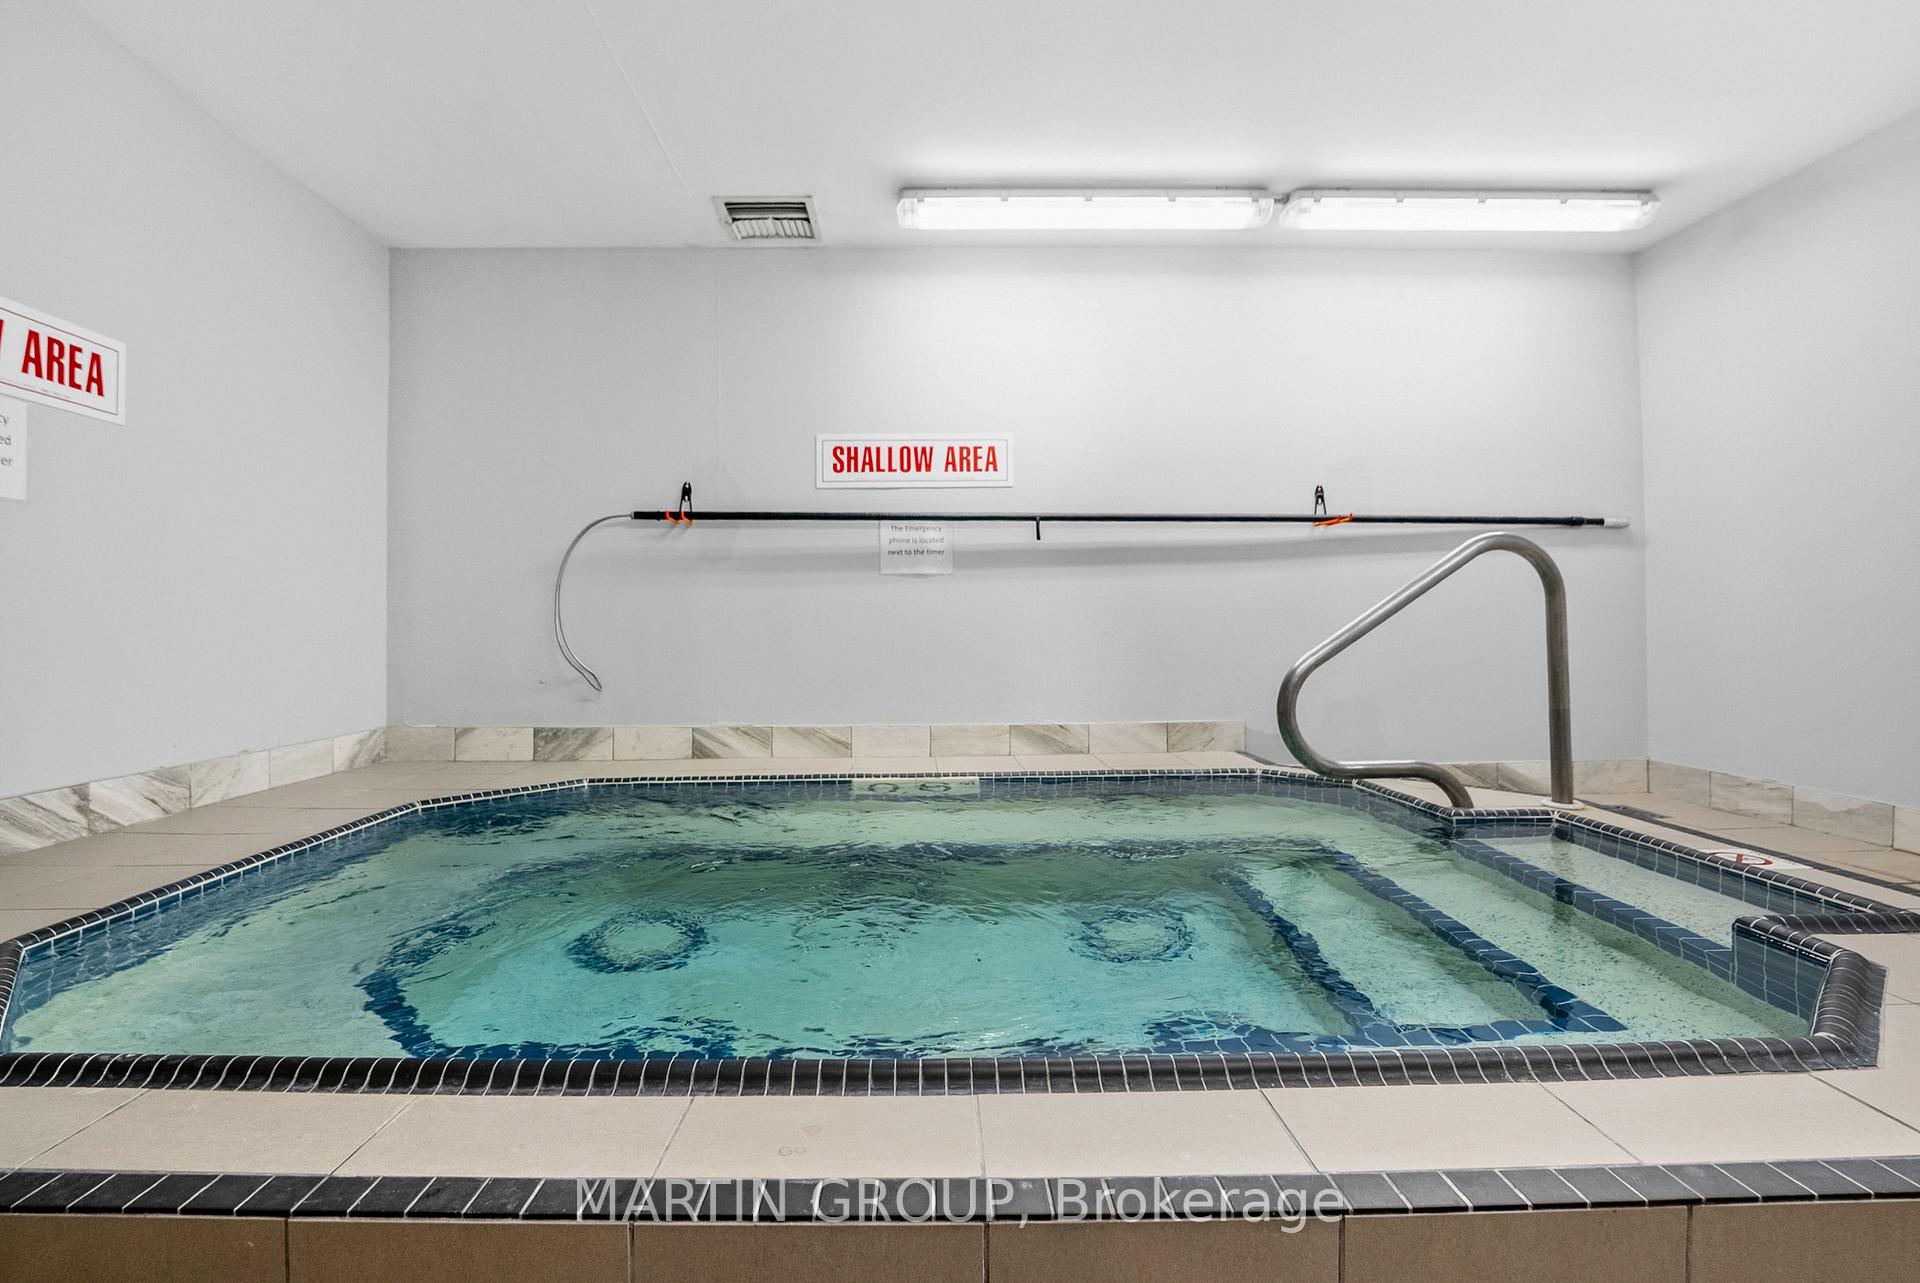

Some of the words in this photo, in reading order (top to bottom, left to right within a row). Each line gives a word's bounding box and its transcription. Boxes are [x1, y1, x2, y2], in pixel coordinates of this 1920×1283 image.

[21, 329, 105, 397] AREA
[832, 445, 934, 474] SHALLOW
[944, 445, 999, 473] AREA
[905, 525, 943, 534] Emergency
[888, 537, 911, 545] phone
[919, 536, 945, 544] located
